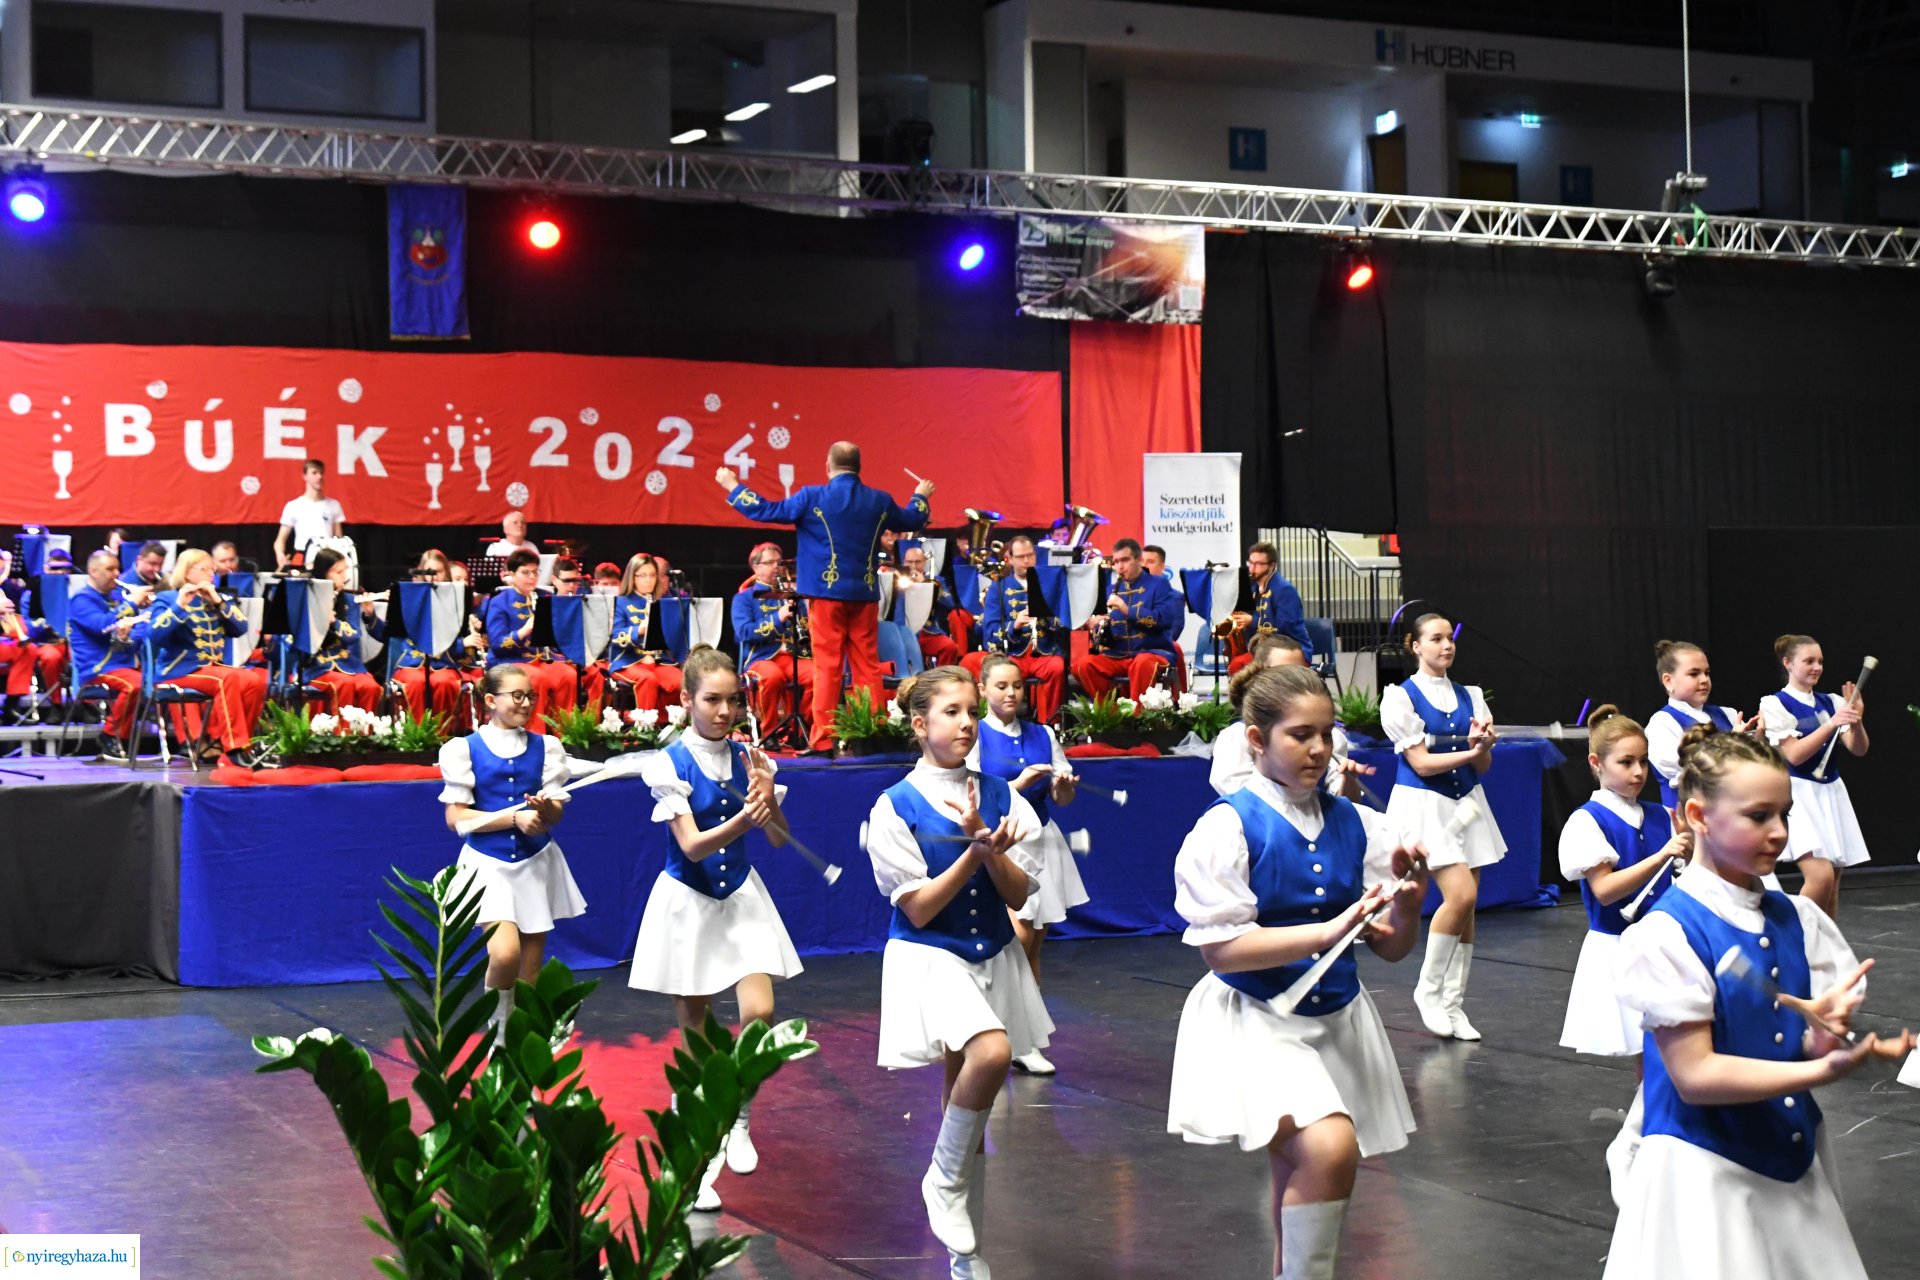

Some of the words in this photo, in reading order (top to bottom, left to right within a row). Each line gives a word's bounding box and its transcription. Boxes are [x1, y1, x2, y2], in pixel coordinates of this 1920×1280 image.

[1411, 43, 1516, 72] HÜBNER
[1086, 237, 1115, 249] Energy
[104, 387, 389, 478] BÚÉK
[528, 416, 757, 481] 2024
[1159, 492, 1225, 505] Szeretettel
[1159, 507, 1226, 521] köszöntjük
[1151, 521, 1233, 535] vendégeinket!
